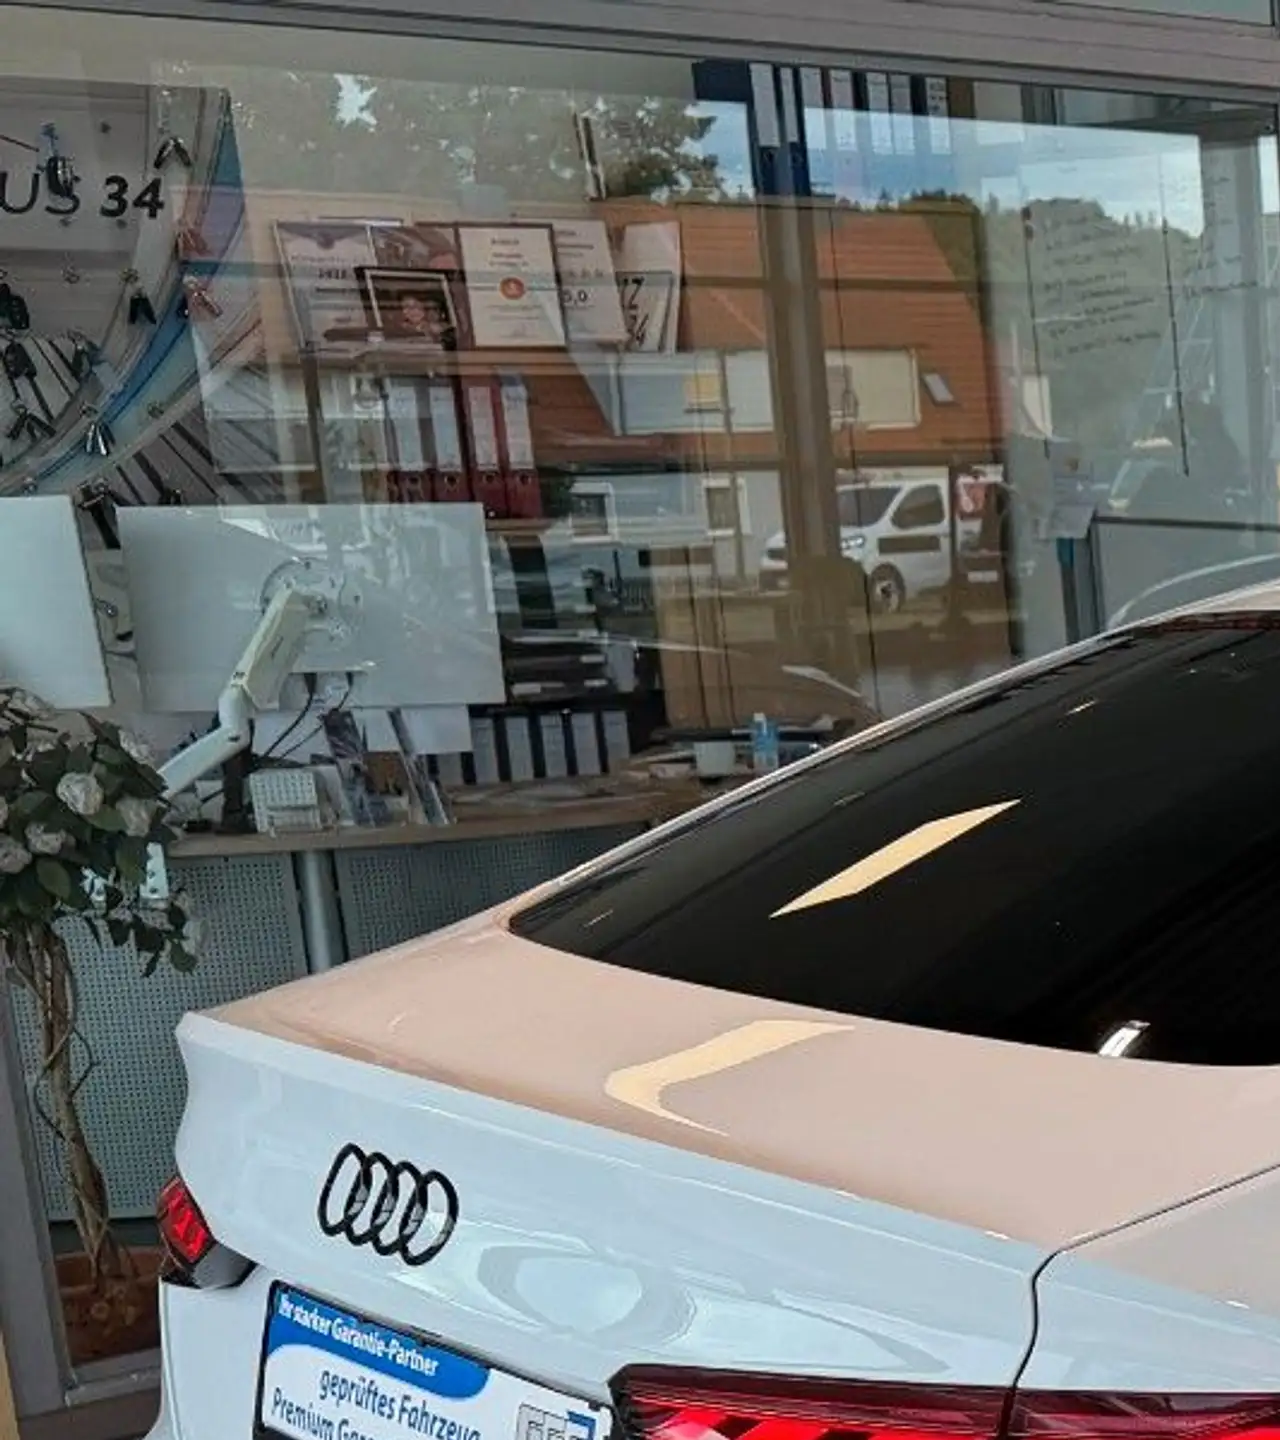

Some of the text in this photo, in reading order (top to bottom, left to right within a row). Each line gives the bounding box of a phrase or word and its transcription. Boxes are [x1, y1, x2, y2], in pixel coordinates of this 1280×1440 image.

[101, 174, 165, 219] 34
[331, 1316, 439, 1377] Garantie-Partner
[319, 1370, 396, 1421] geprüftes
